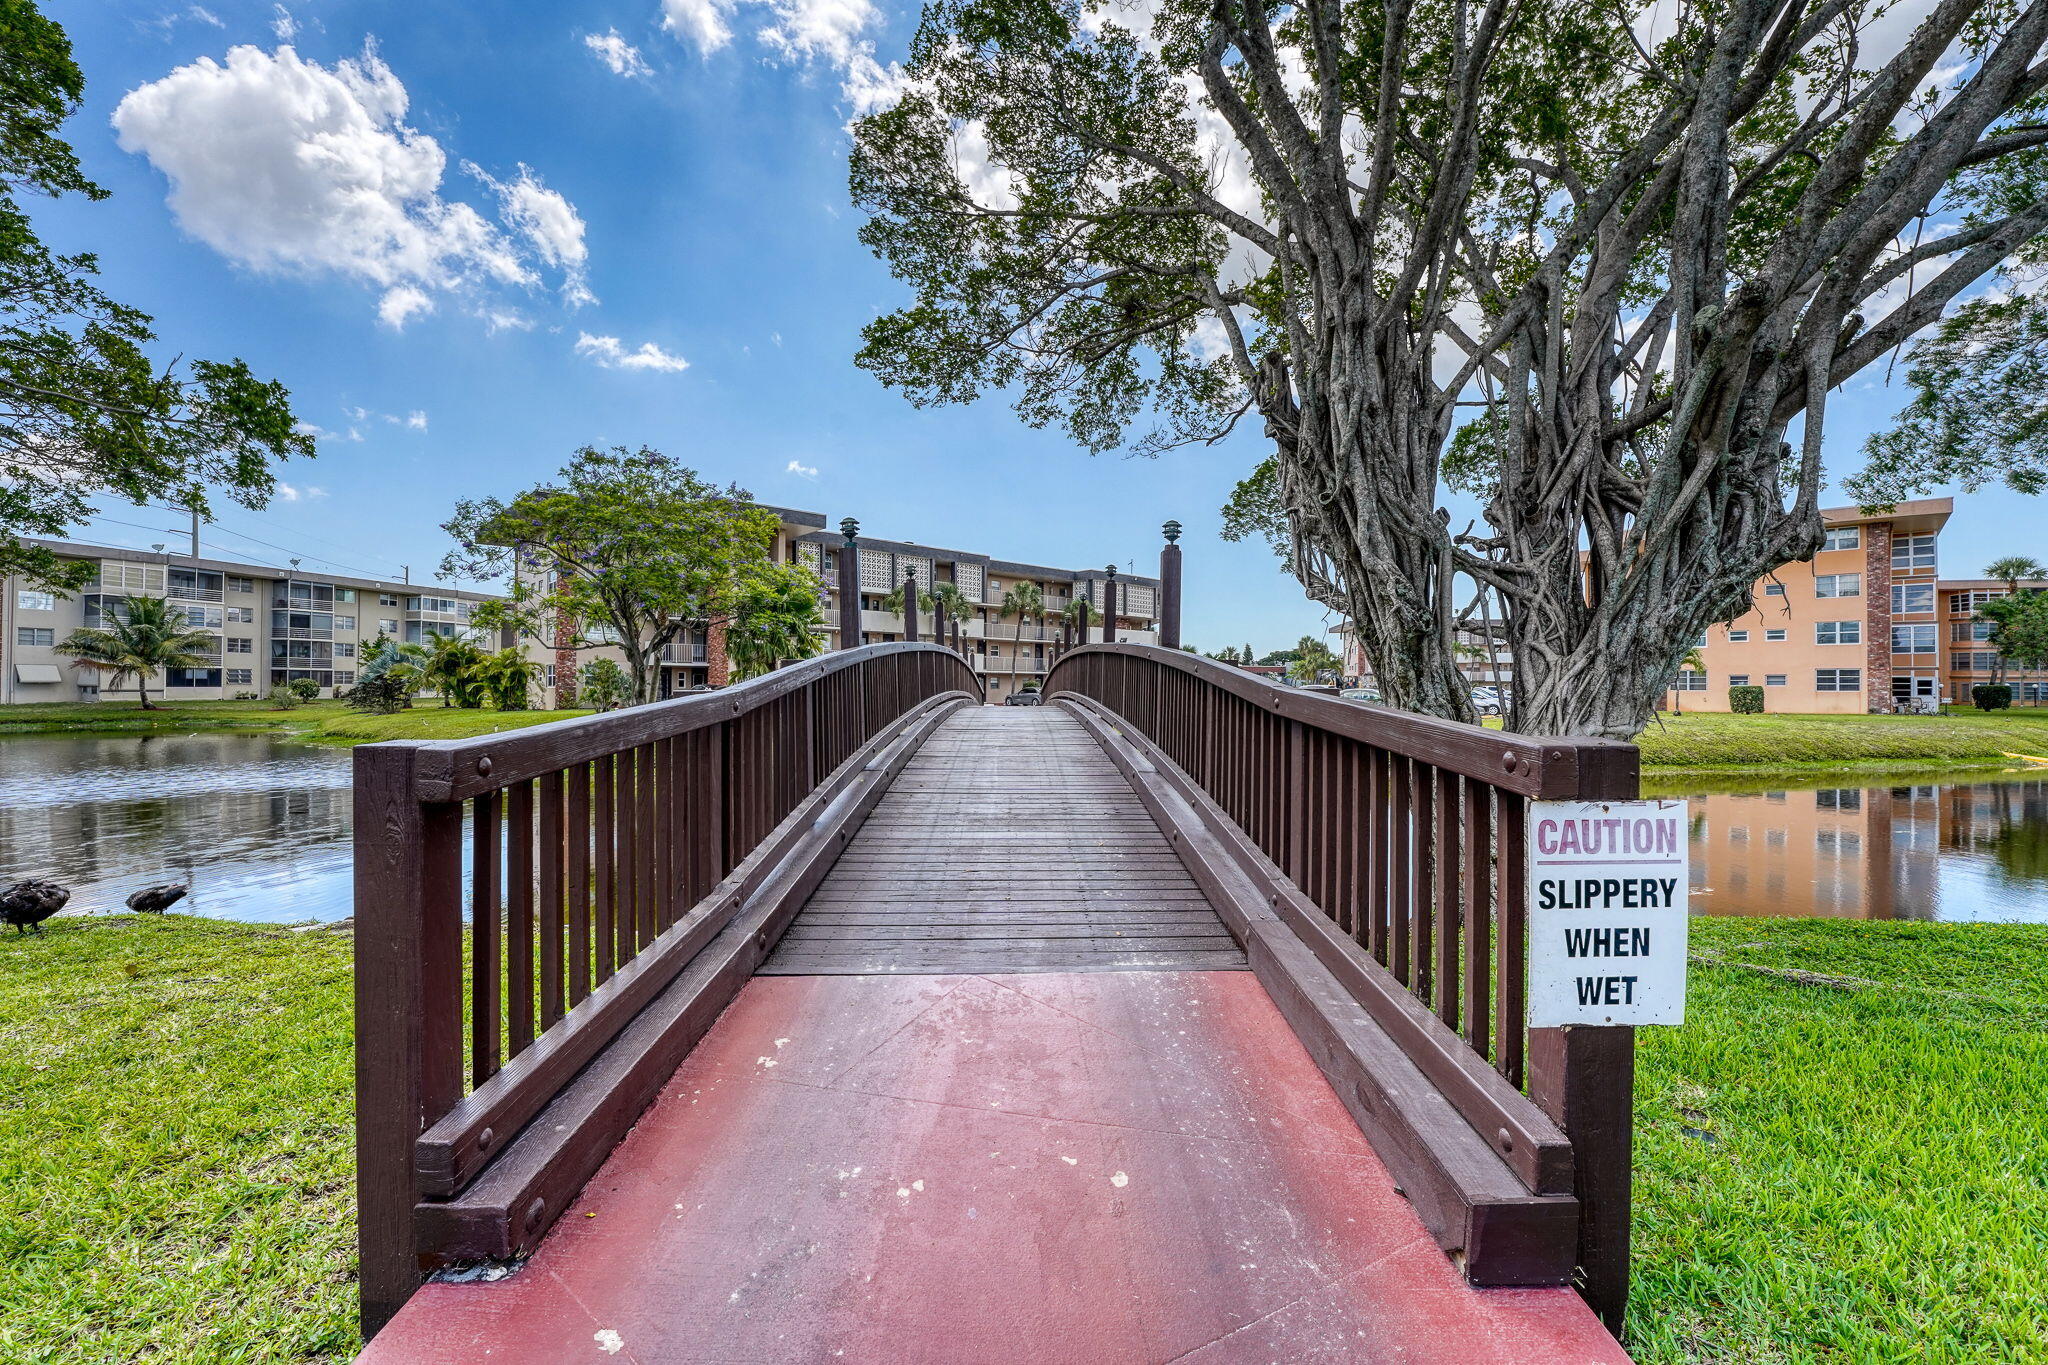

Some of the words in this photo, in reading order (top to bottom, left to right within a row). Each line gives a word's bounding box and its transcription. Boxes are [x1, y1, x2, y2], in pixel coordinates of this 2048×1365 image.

[1537, 818, 1677, 855] CAUTION
[1538, 878, 1678, 909] SLIPPERY
[1565, 927, 1650, 957] WHEN
[1576, 976, 1638, 1005] WET
